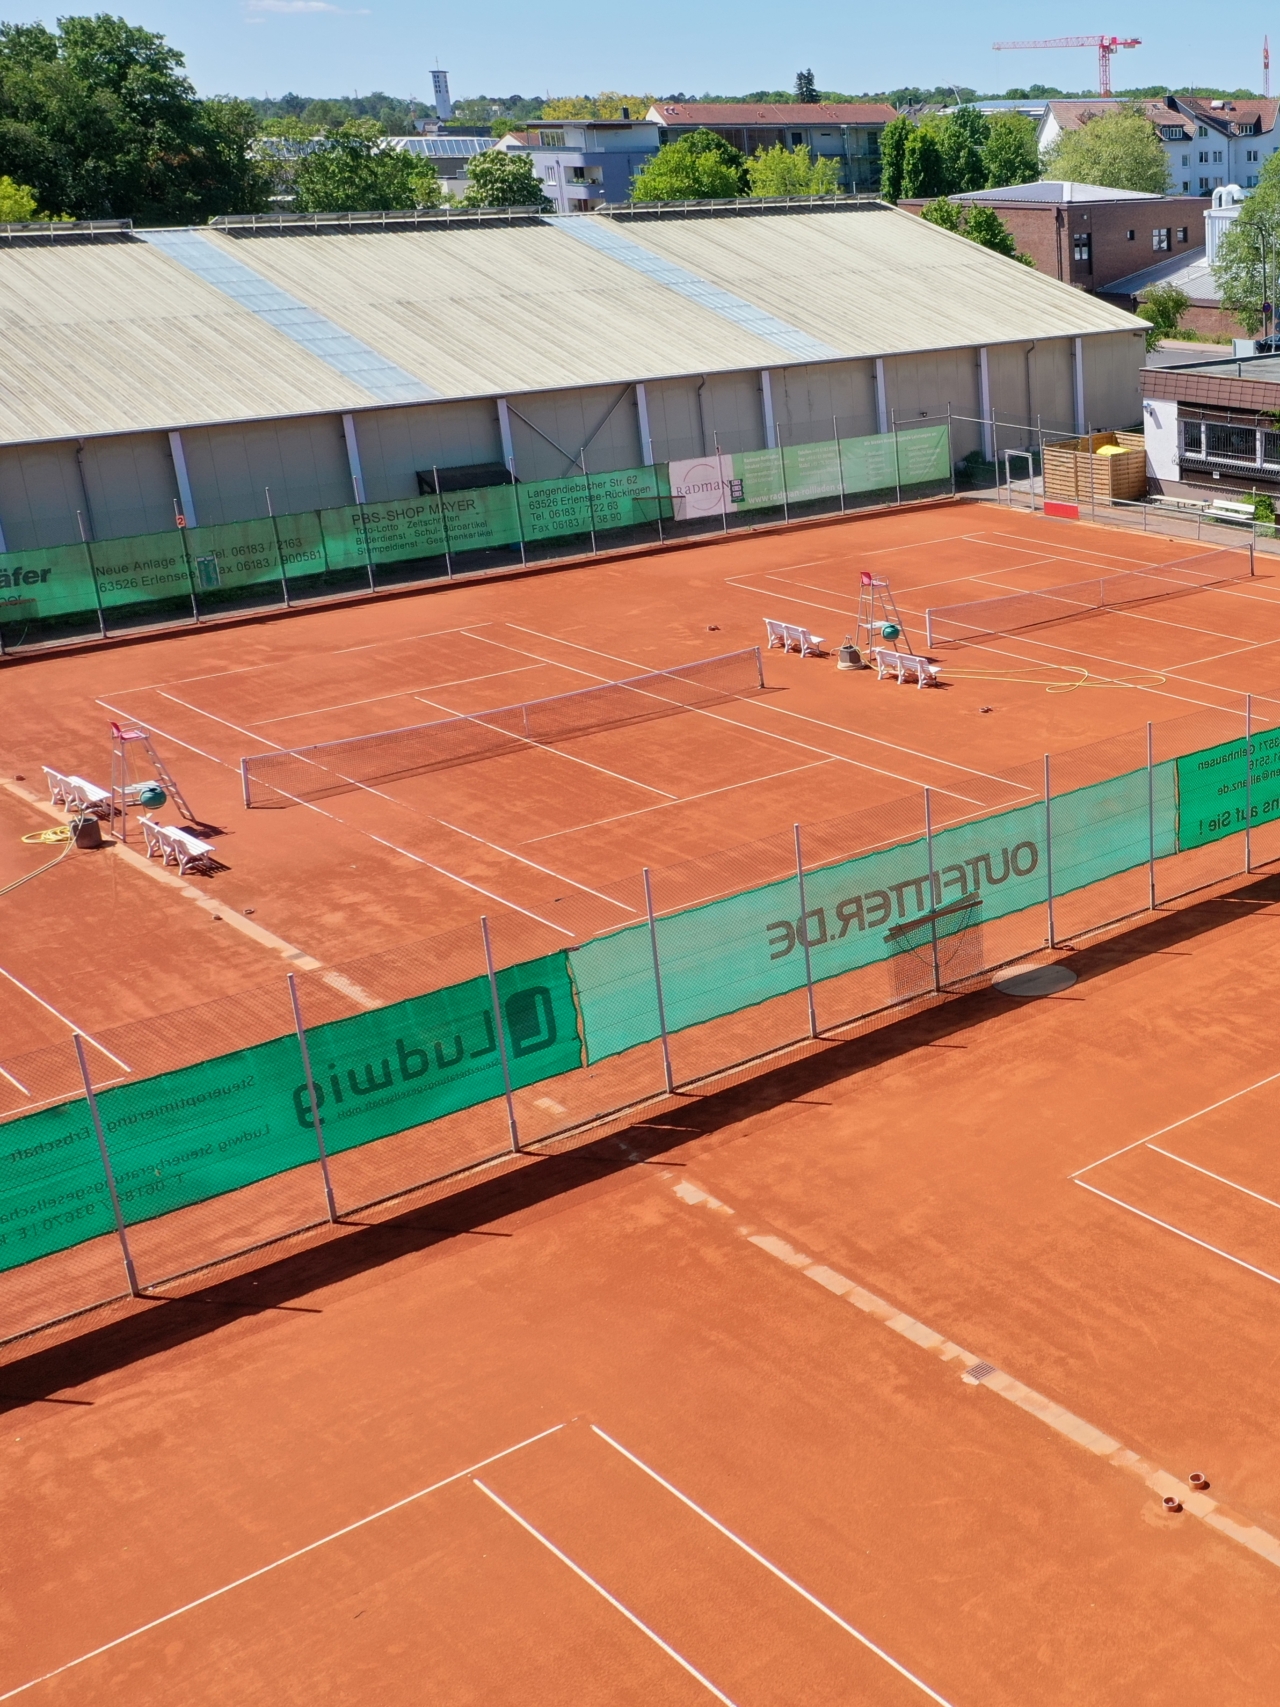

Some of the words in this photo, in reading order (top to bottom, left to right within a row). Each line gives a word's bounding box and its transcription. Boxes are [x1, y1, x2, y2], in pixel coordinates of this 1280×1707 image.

[527, 481, 606, 498] Langendiebacher
[610, 478, 624, 488] Str.
[627, 475, 638, 484] 62
[529, 498, 558, 510] 63526
[561, 485, 650, 506] Erlensee-Rückingen
[178, 517, 183, 525] 2
[352, 506, 424, 525] PBS-SHOP
[429, 499, 476, 515] MAYER
[531, 512, 546, 521] Tel.
[549, 508, 576, 519] 06183
[594, 503, 604, 512] 22
[607, 501, 618, 511] 63
[532, 524, 550, 533] Fax
[552, 518, 579, 530] 06183
[597, 514, 607, 523] 38
[611, 512, 621, 521] 90
[356, 533, 406, 545] Bilderdienst
[414, 527, 441, 537] Schul-
[444, 520, 487, 533] Büroartikel
[358, 541, 418, 555] Stempeldienst
[426, 529, 494, 545] Geschenkartikel
[209, 549, 228, 560] Tel.
[231, 544, 265, 556] 06183
[277, 537, 302, 550] 2163
[96, 566, 128, 577] Neue
[133, 558, 176, 573] Anlage
[219, 565, 233, 574] ax
[237, 559, 270, 573] 06183
[281, 550, 321, 565] 900581
[99, 577, 138, 593] 63526
[141, 570, 196, 586] Erlensee
